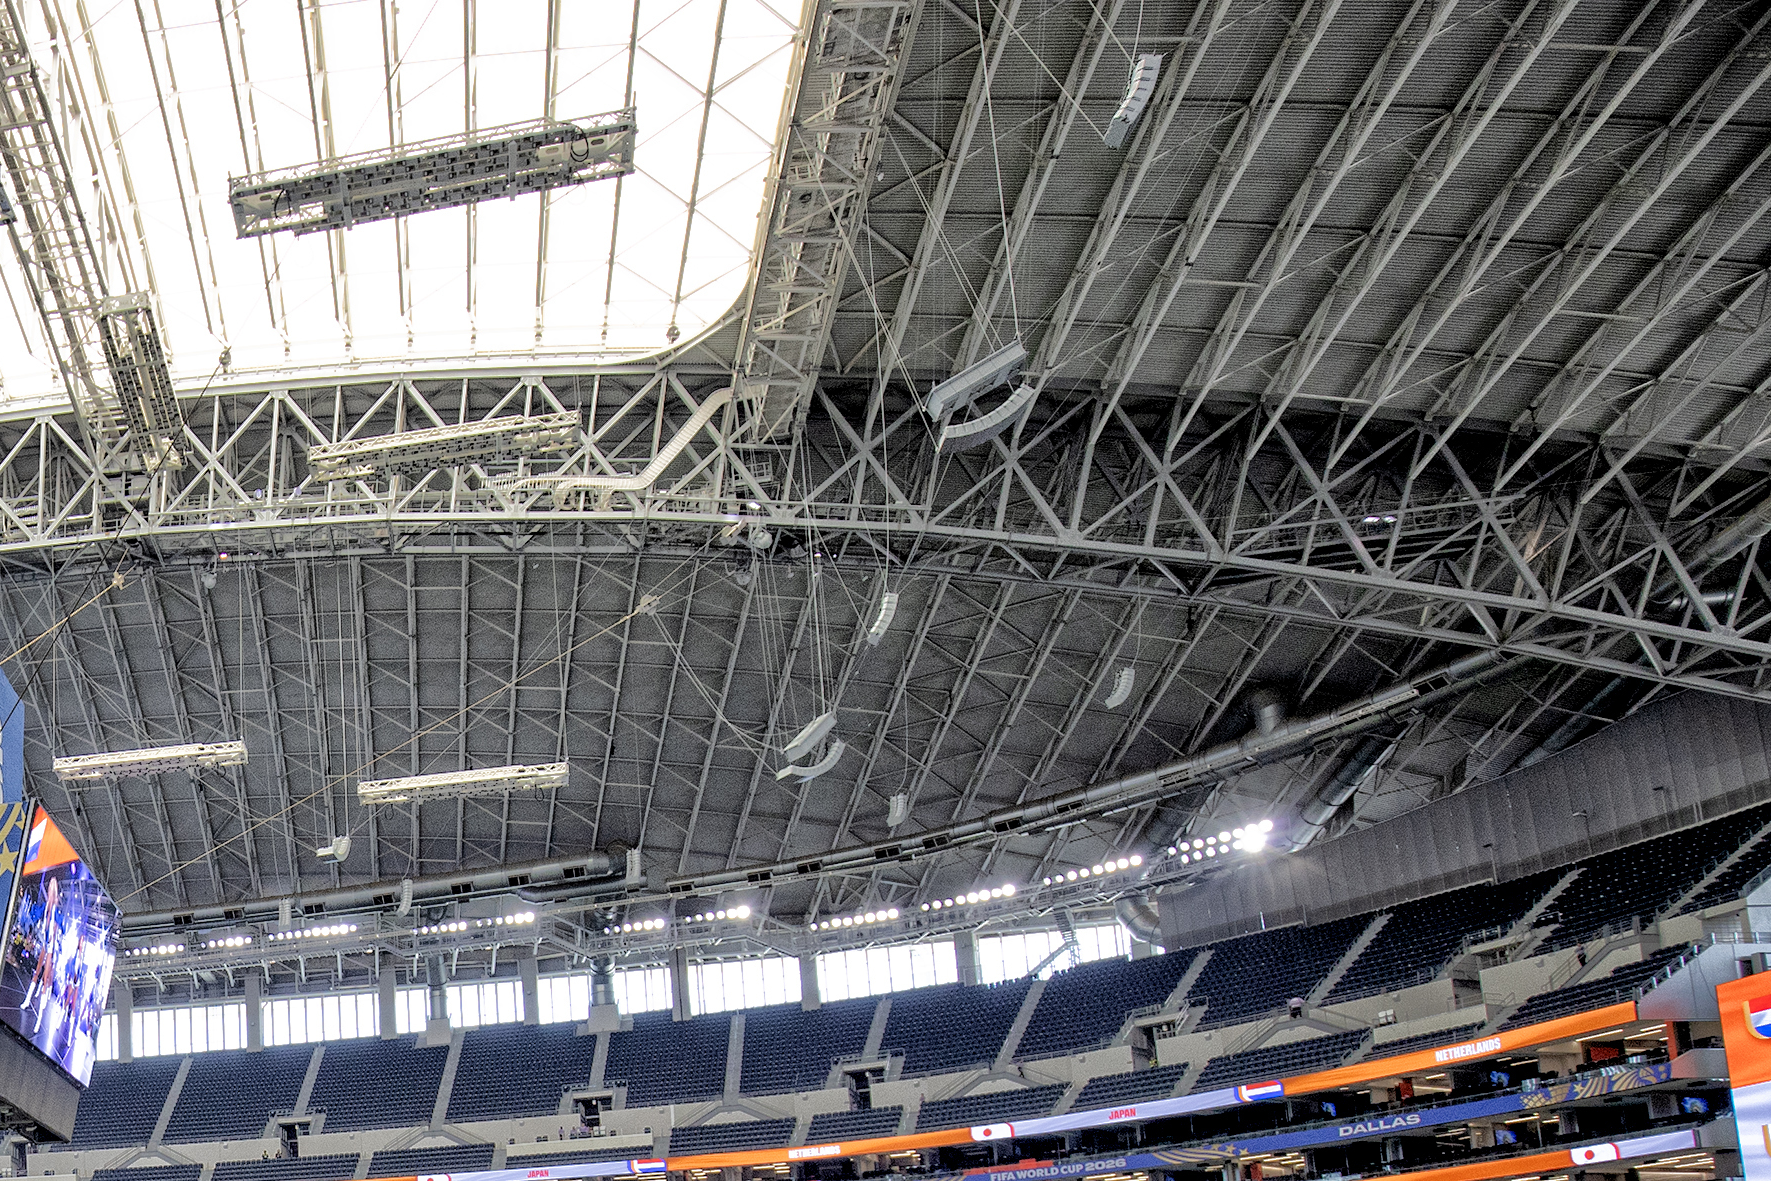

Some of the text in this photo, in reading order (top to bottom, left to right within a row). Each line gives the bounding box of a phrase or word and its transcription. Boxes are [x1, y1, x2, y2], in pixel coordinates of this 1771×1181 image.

[1435, 1037, 1502, 1062] NETHERLANDS
[1108, 1107, 1137, 1120] JAPAN
[1338, 1114, 1422, 1136] DALLAS
[788, 1145, 841, 1159] NETHERLANDS
[527, 1170, 550, 1178] JAPAN
[990, 1158, 1127, 1181] FIFA WORLD CUP 2026
